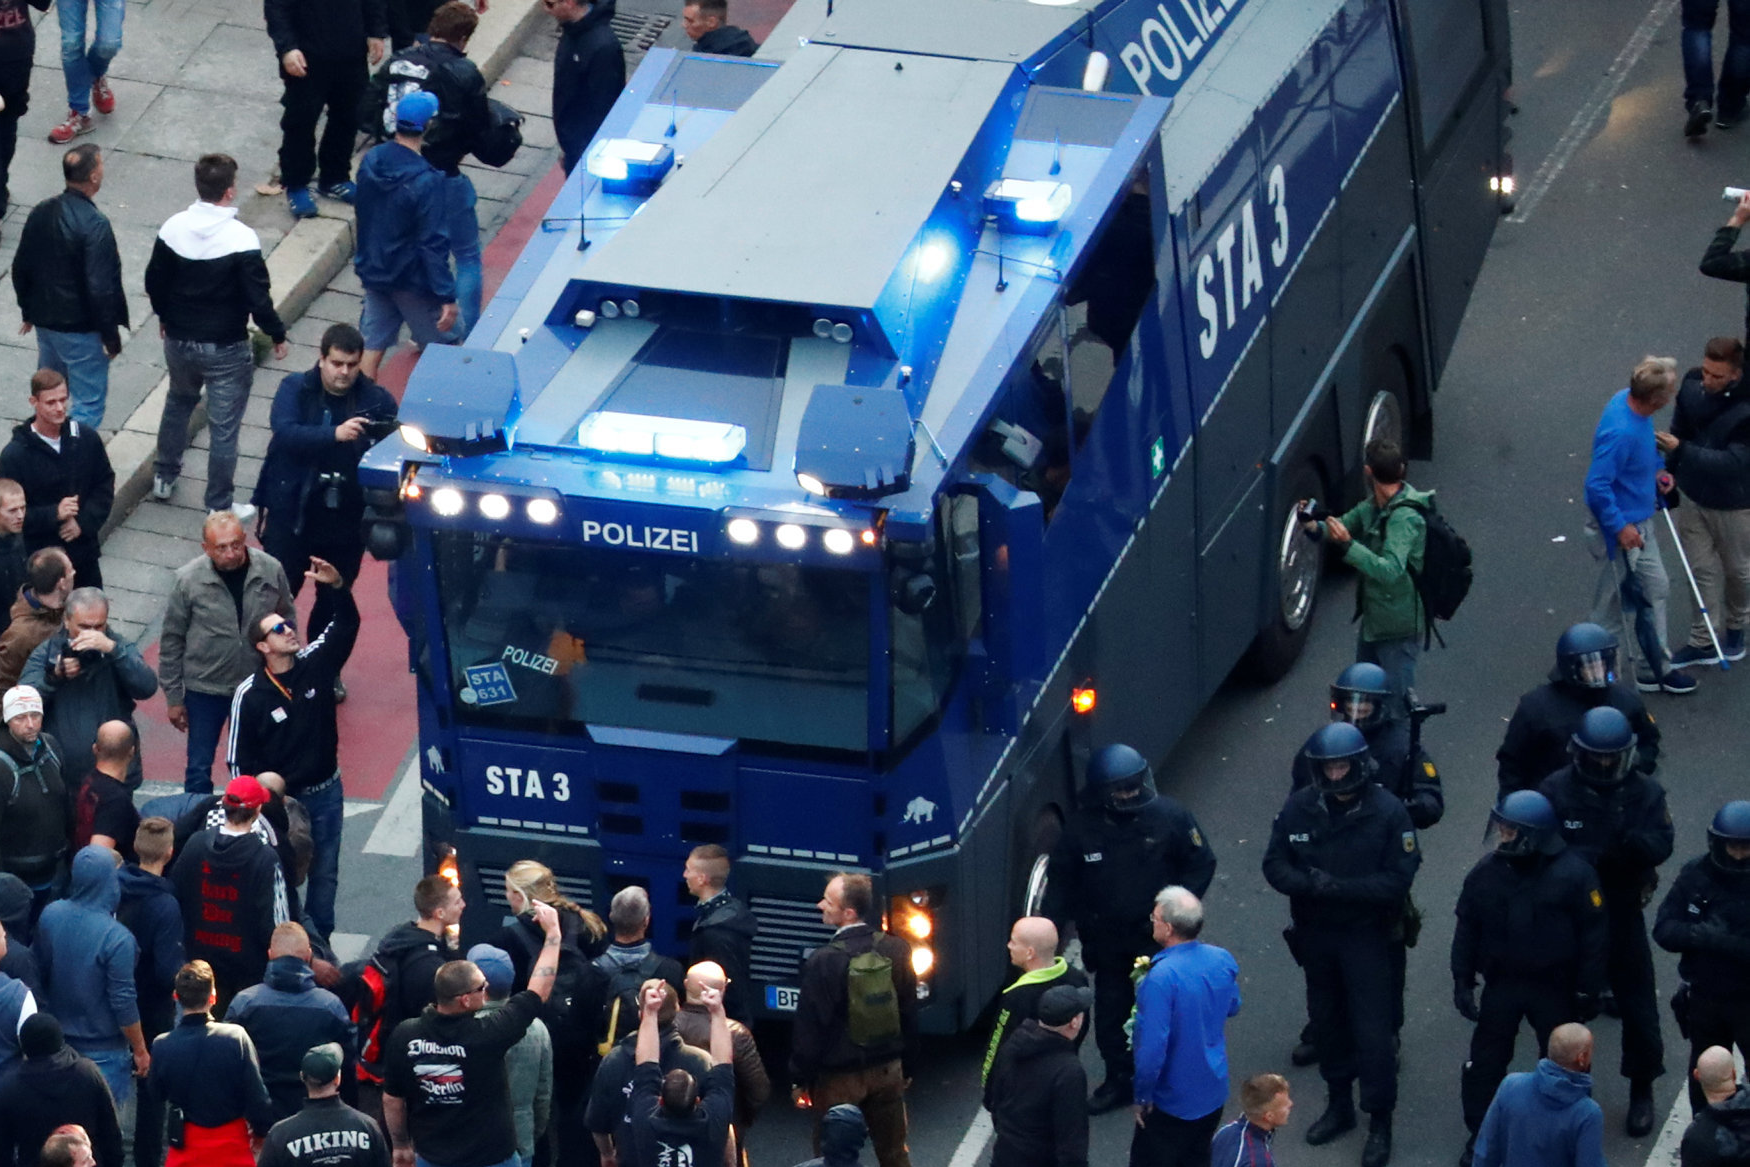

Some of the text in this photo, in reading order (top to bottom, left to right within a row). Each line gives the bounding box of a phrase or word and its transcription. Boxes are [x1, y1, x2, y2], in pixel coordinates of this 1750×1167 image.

[1197, 164, 1289, 359] STA 3
[583, 520, 698, 552] POLIZEI
[502, 645, 558, 675] POLIZEI
[471, 670, 505, 685] STA
[478, 686, 507, 700] 631
[486, 765, 570, 801] STA 3
[407, 1039, 467, 1058] Division
[287, 1130, 370, 1158] VIKING
